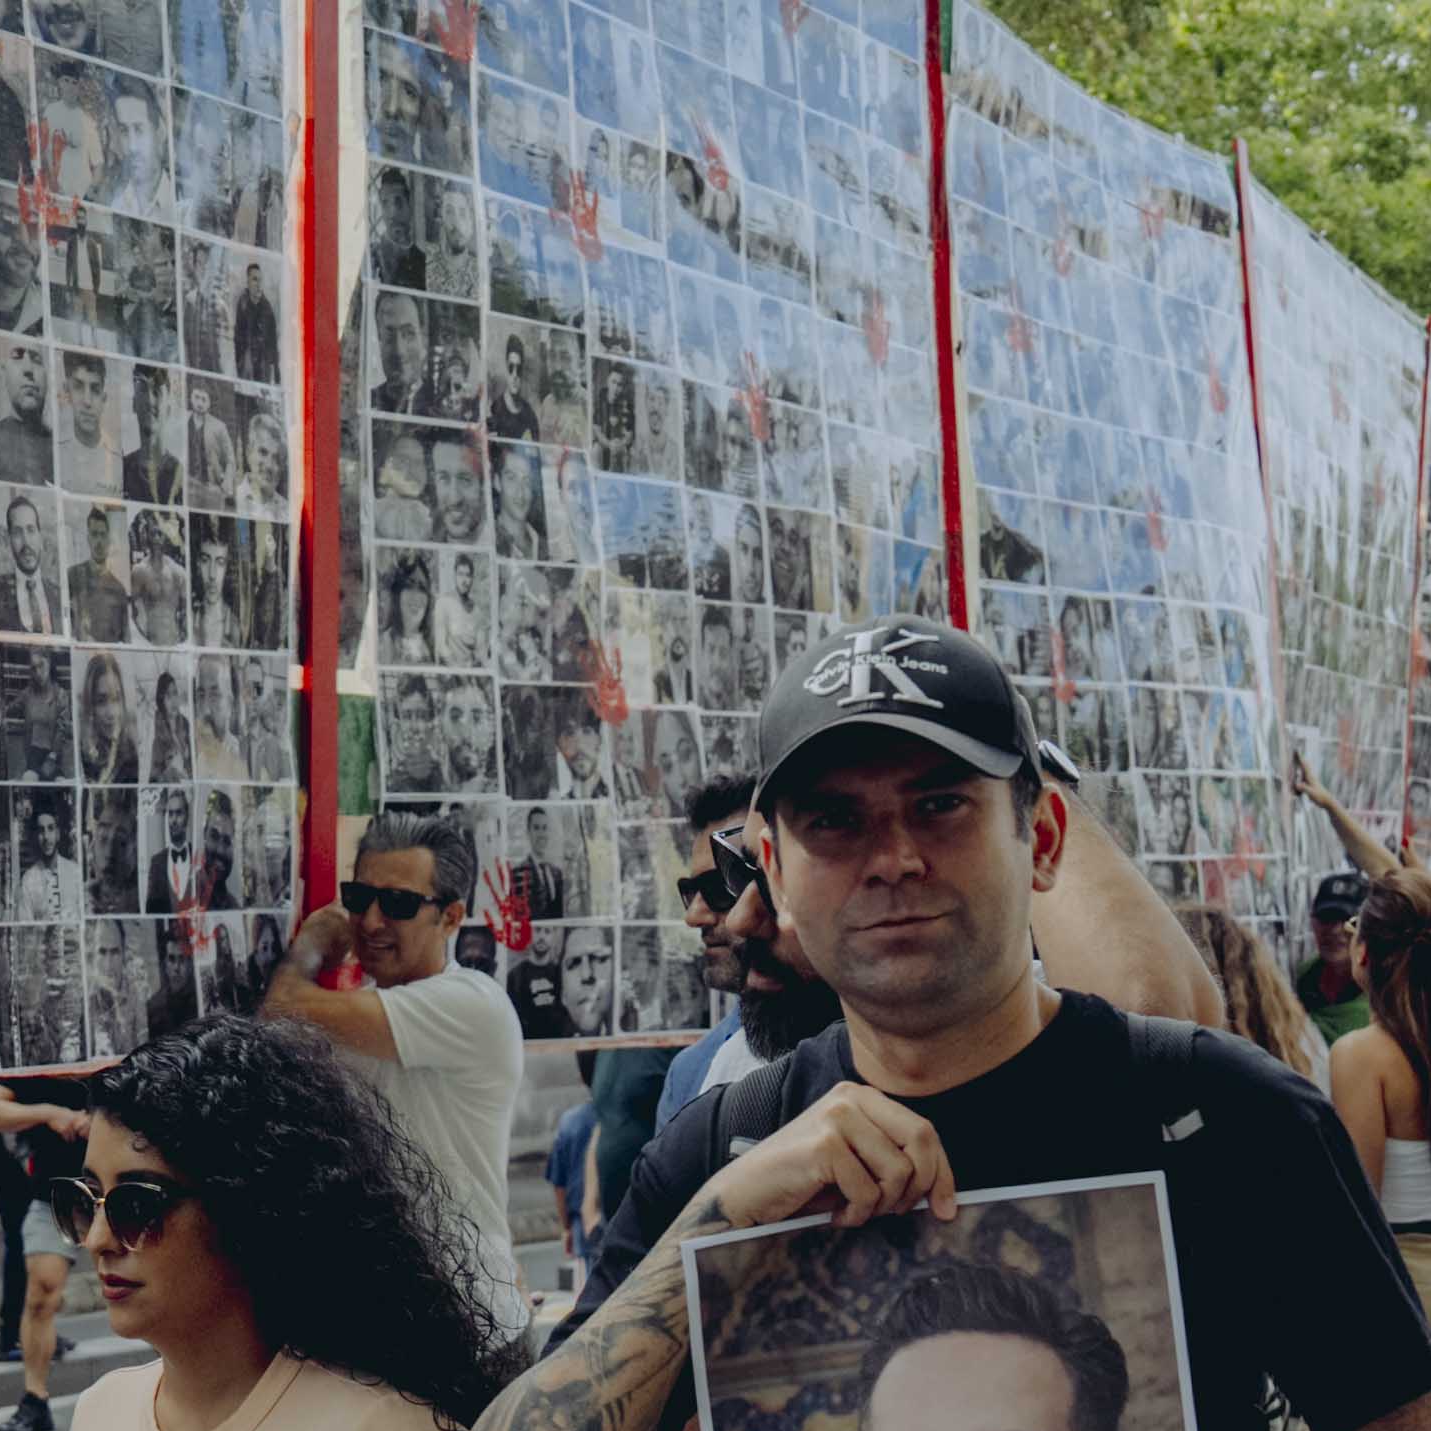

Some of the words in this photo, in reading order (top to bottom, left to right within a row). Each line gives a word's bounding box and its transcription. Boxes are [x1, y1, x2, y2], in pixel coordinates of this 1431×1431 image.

[803, 659, 852, 690] Calvin
[854, 652, 897, 667] Klein
[900, 655, 949, 675] Jeans
